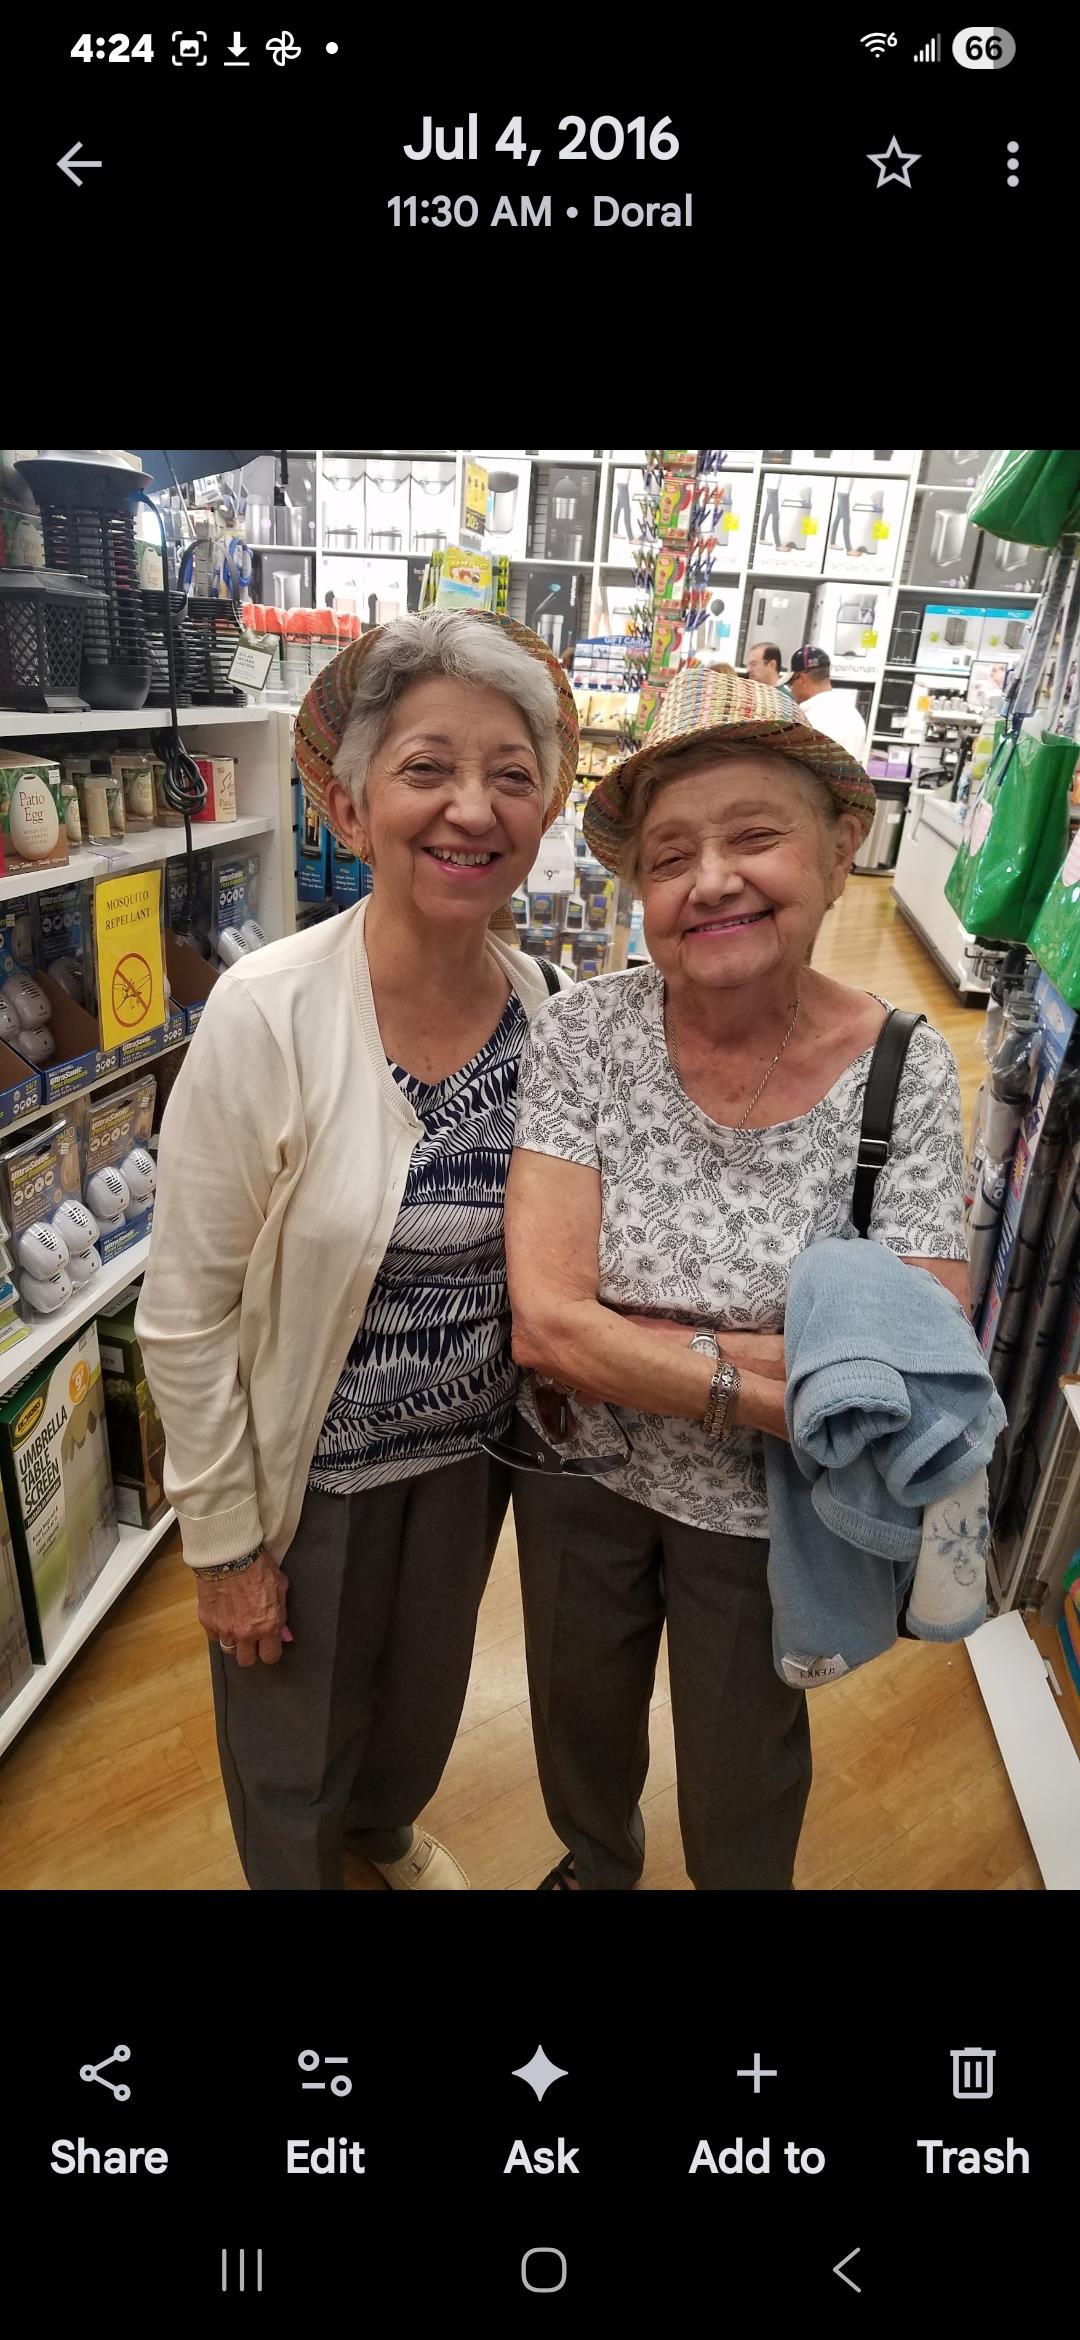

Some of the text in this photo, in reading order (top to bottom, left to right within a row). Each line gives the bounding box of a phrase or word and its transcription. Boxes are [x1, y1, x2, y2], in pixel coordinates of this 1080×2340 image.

[19, 791, 45, 807] Patio
[24, 807, 44, 824] Egg
[106, 891, 150, 912] MOSQUITO
[105, 907, 151, 931] REPELLANT
[19, 1405, 68, 1476] UMBRELLA
[21, 1447, 51, 1494] TABLE
[24, 1457, 60, 1515] SCREEN
